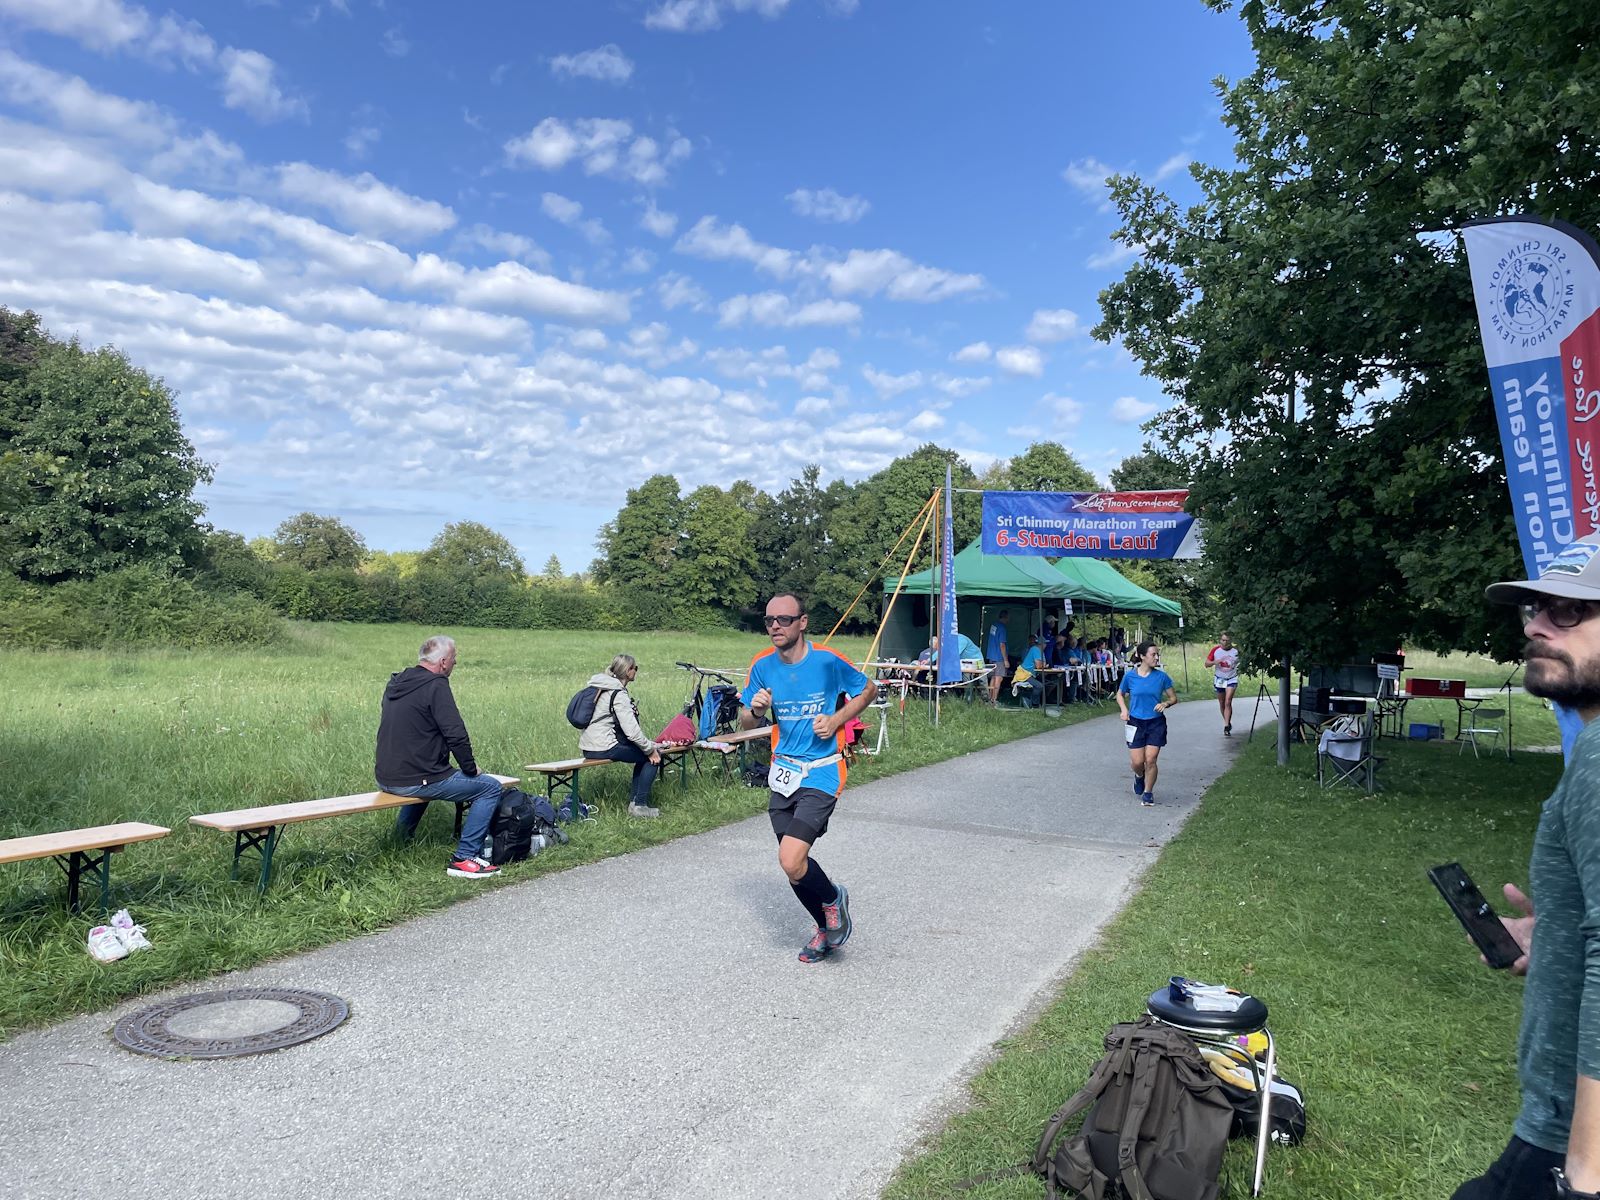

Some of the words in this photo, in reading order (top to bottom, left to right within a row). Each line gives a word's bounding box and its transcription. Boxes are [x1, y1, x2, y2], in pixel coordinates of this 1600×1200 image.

[996, 515, 1013, 527] Sri
[1016, 515, 1069, 532] Chinmoy
[1073, 517, 1137, 530] Marathon
[1141, 517, 1177, 529] Team
[996, 530, 1101, 550] 6-Stunden
[1109, 530, 1159, 550] Lauf
[775, 767, 791, 785] 28
